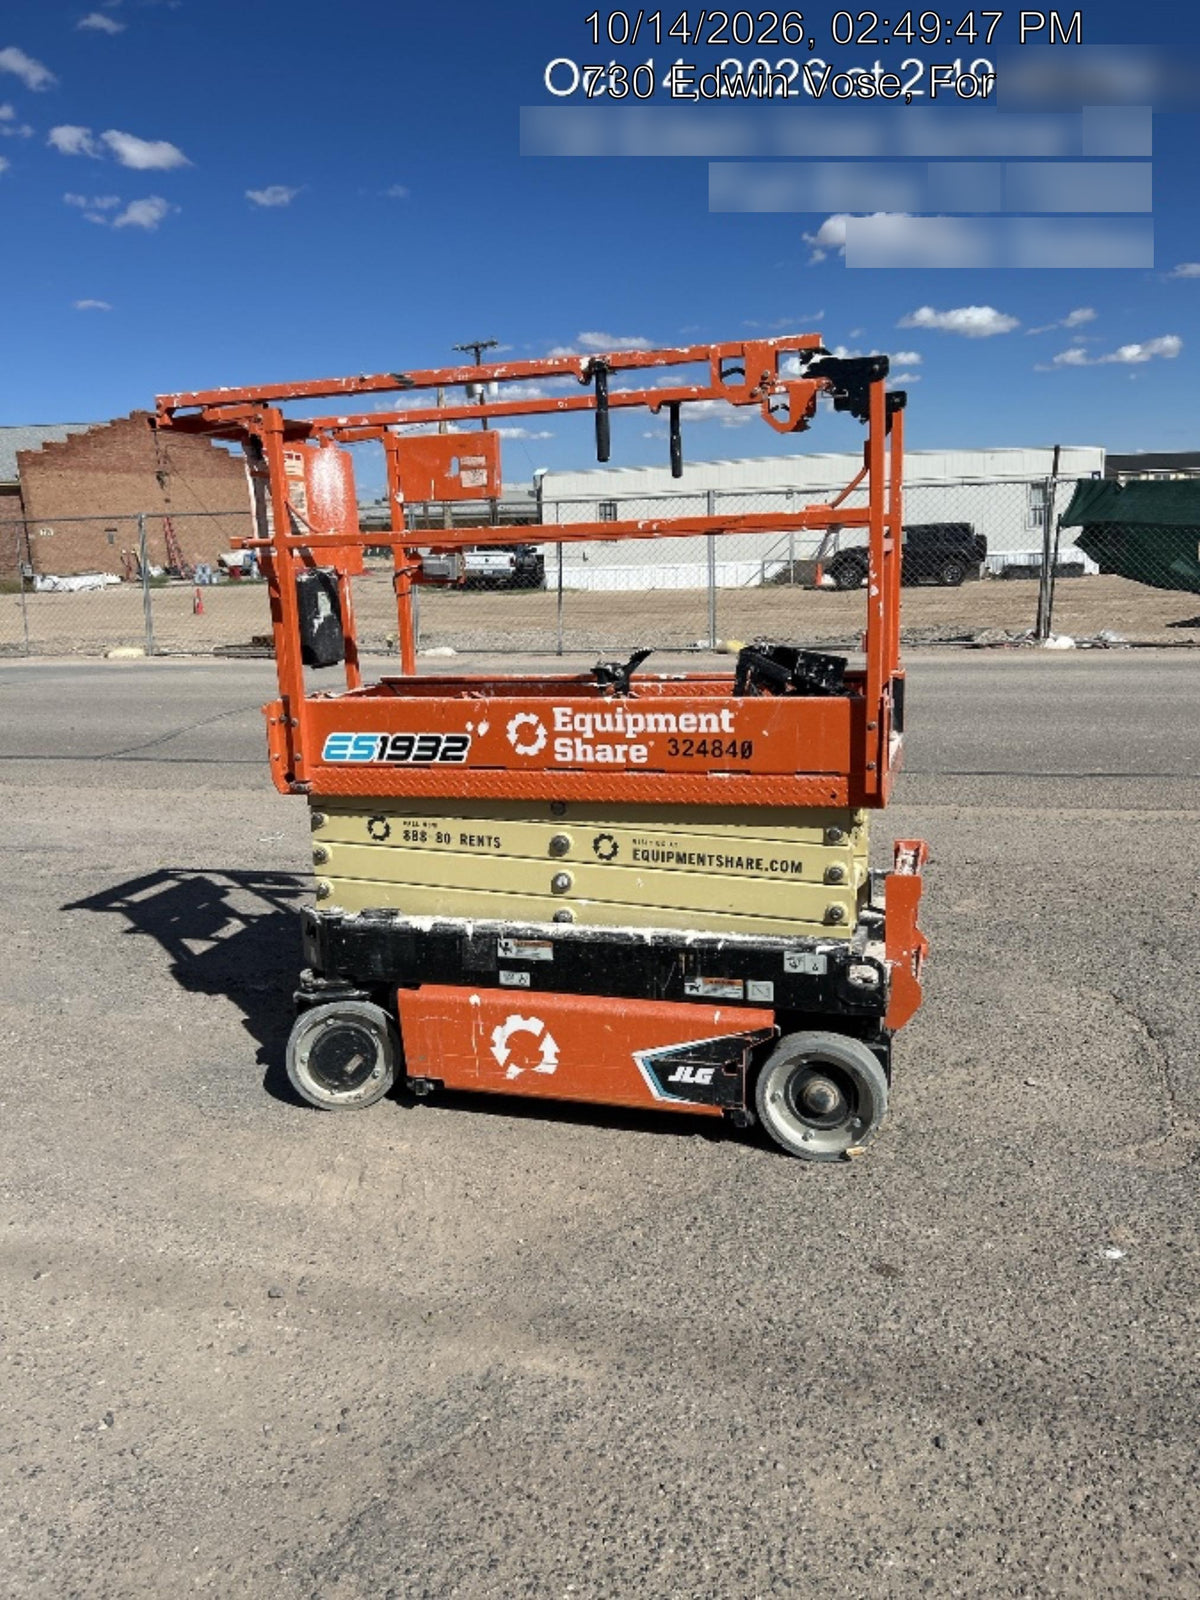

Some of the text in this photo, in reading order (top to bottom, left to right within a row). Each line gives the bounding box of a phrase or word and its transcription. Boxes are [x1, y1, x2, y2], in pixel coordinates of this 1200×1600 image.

[552, 706, 735, 738] Equipment
[322, 732, 471, 763] ES1932
[553, 737, 648, 763] Share
[667, 738, 753, 760] 324840
[459, 833, 501, 849] RENTS
[632, 848, 803, 874] EQUIPMENTSHARE.COM
[667, 1066, 716, 1085] JLG
